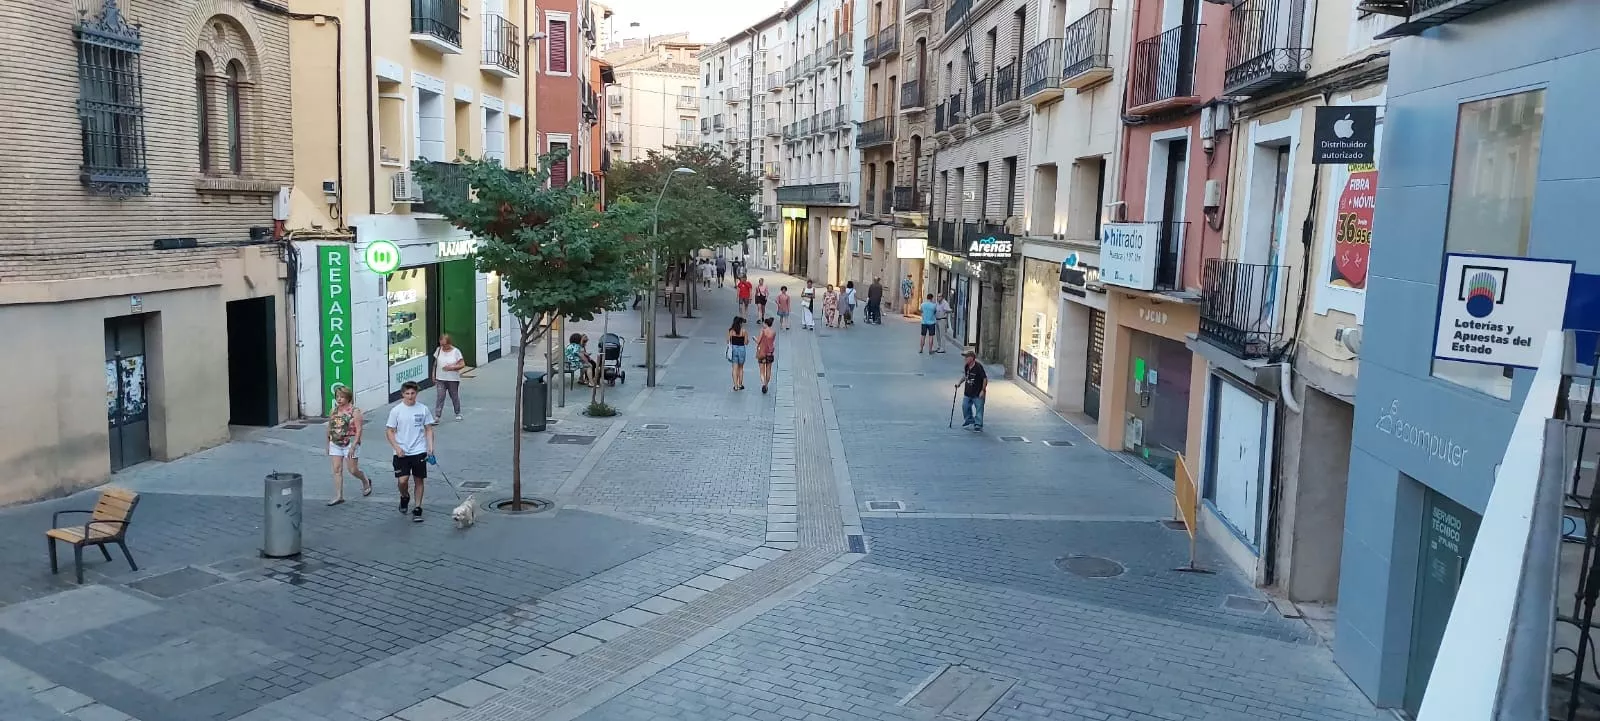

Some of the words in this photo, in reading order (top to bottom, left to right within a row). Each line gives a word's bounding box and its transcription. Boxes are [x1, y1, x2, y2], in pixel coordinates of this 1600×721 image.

[1321, 151, 1363, 159] autorizado
[1350, 178, 1370, 190] FIBRA
[1352, 192, 1376, 209] MÓVIL
[969, 240, 1013, 253] Arenas
[1110, 228, 1143, 249] hitradio
[1454, 319, 1503, 332] Loterías
[1506, 325, 1514, 335] y
[1453, 330, 1509, 344] Apuestas
[1512, 336, 1531, 347] del
[1452, 342, 1492, 354] Estado
[1433, 507, 1461, 530] SERVICIO
